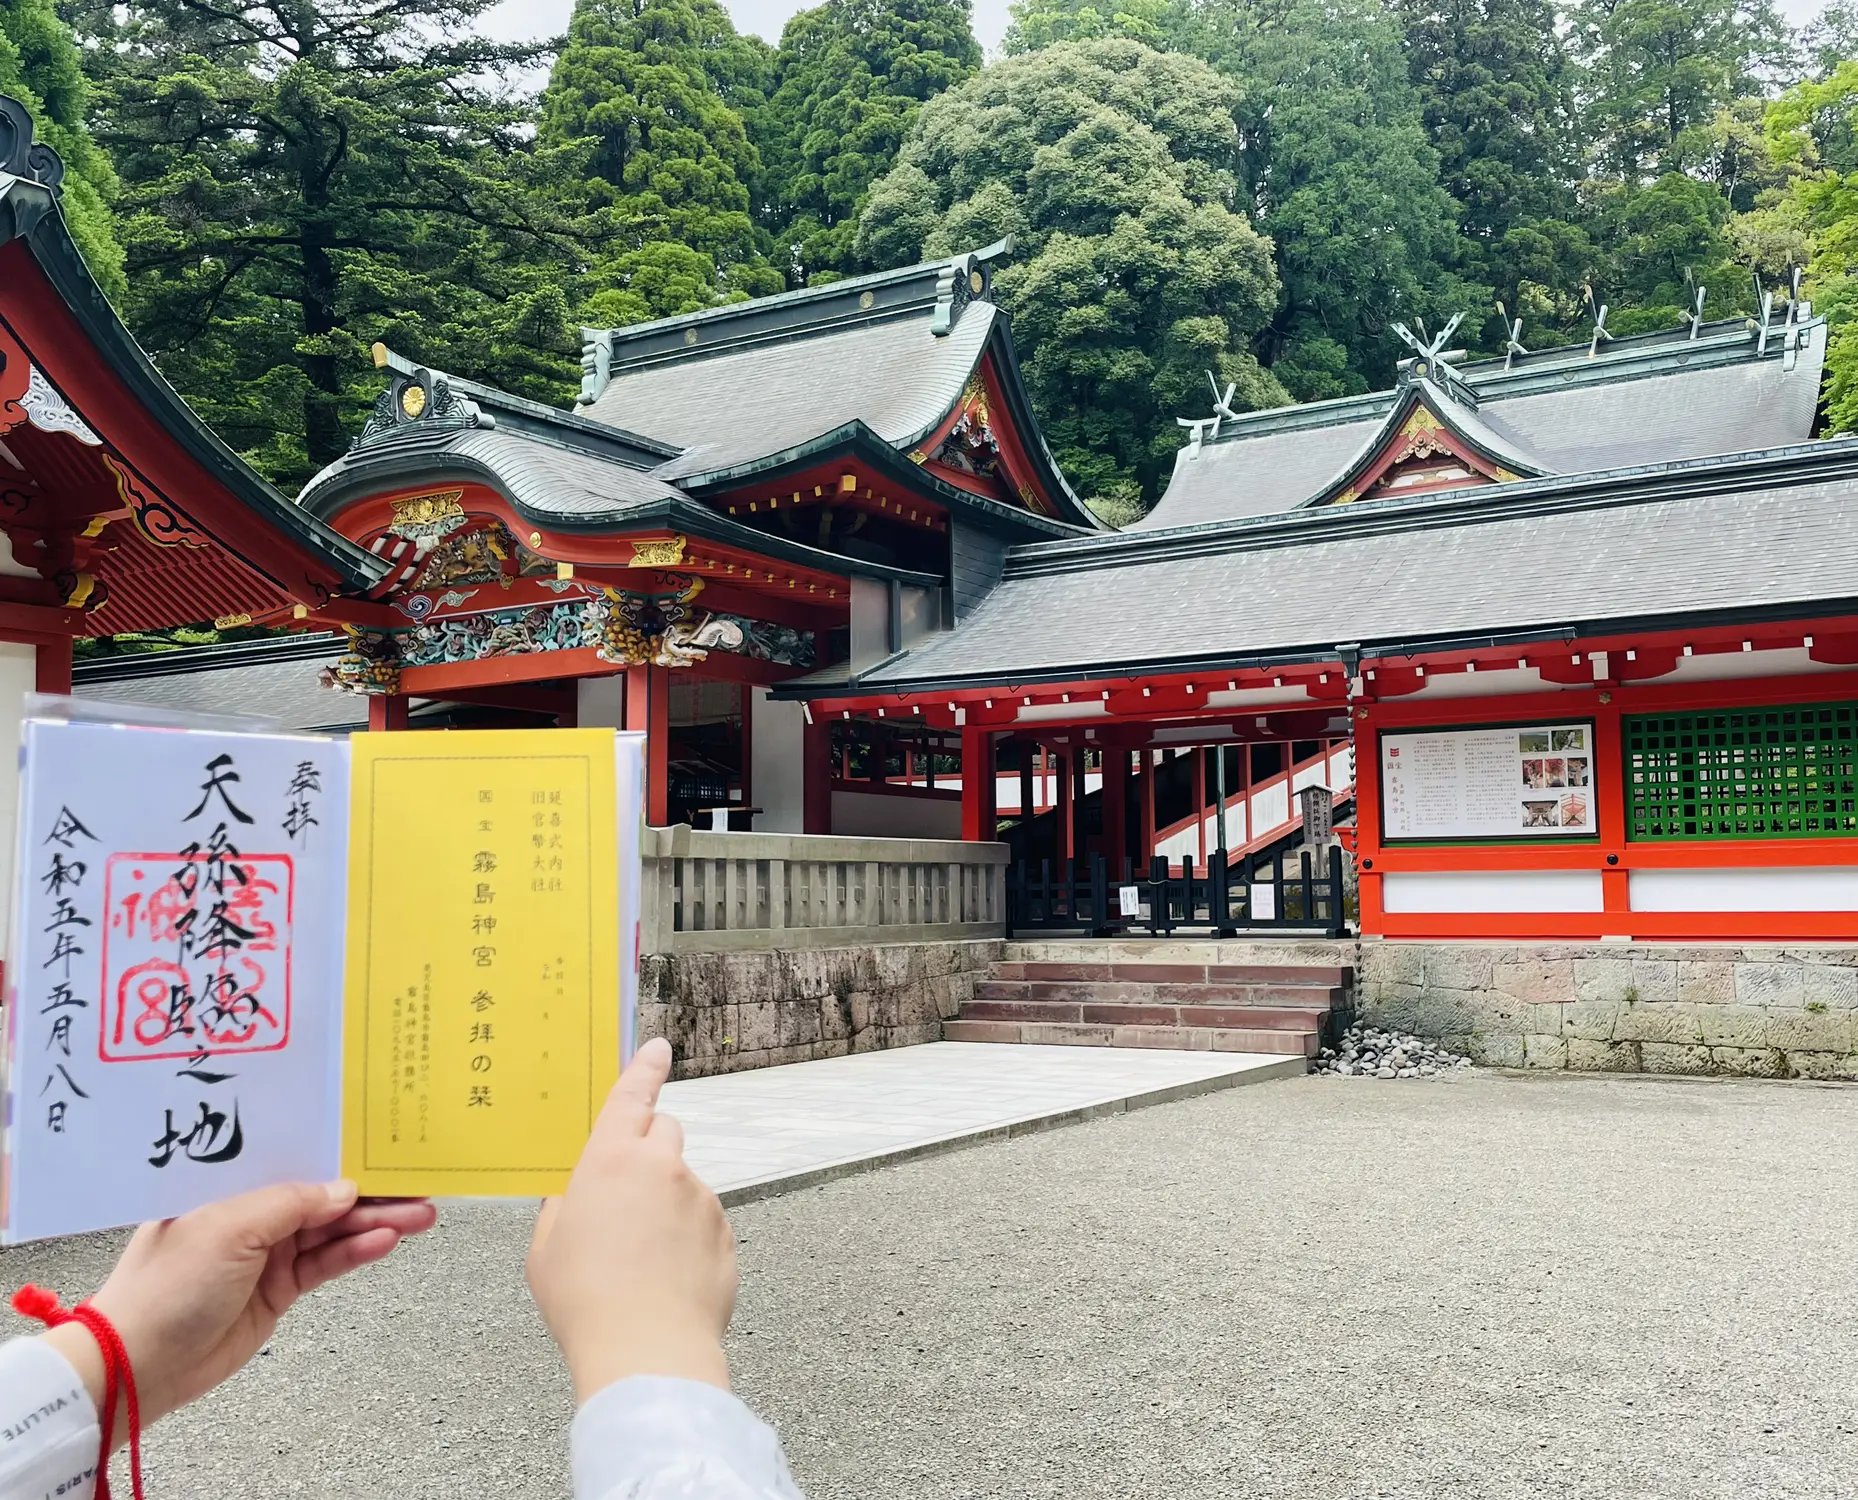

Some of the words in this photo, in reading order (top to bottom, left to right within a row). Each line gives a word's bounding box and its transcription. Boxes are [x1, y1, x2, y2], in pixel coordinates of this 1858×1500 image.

[471, 850, 497, 967] 霧島神宮
[40, 804, 101, 1134] 令和五年五月八日
[467, 989, 496, 1107] 参拝の栞
